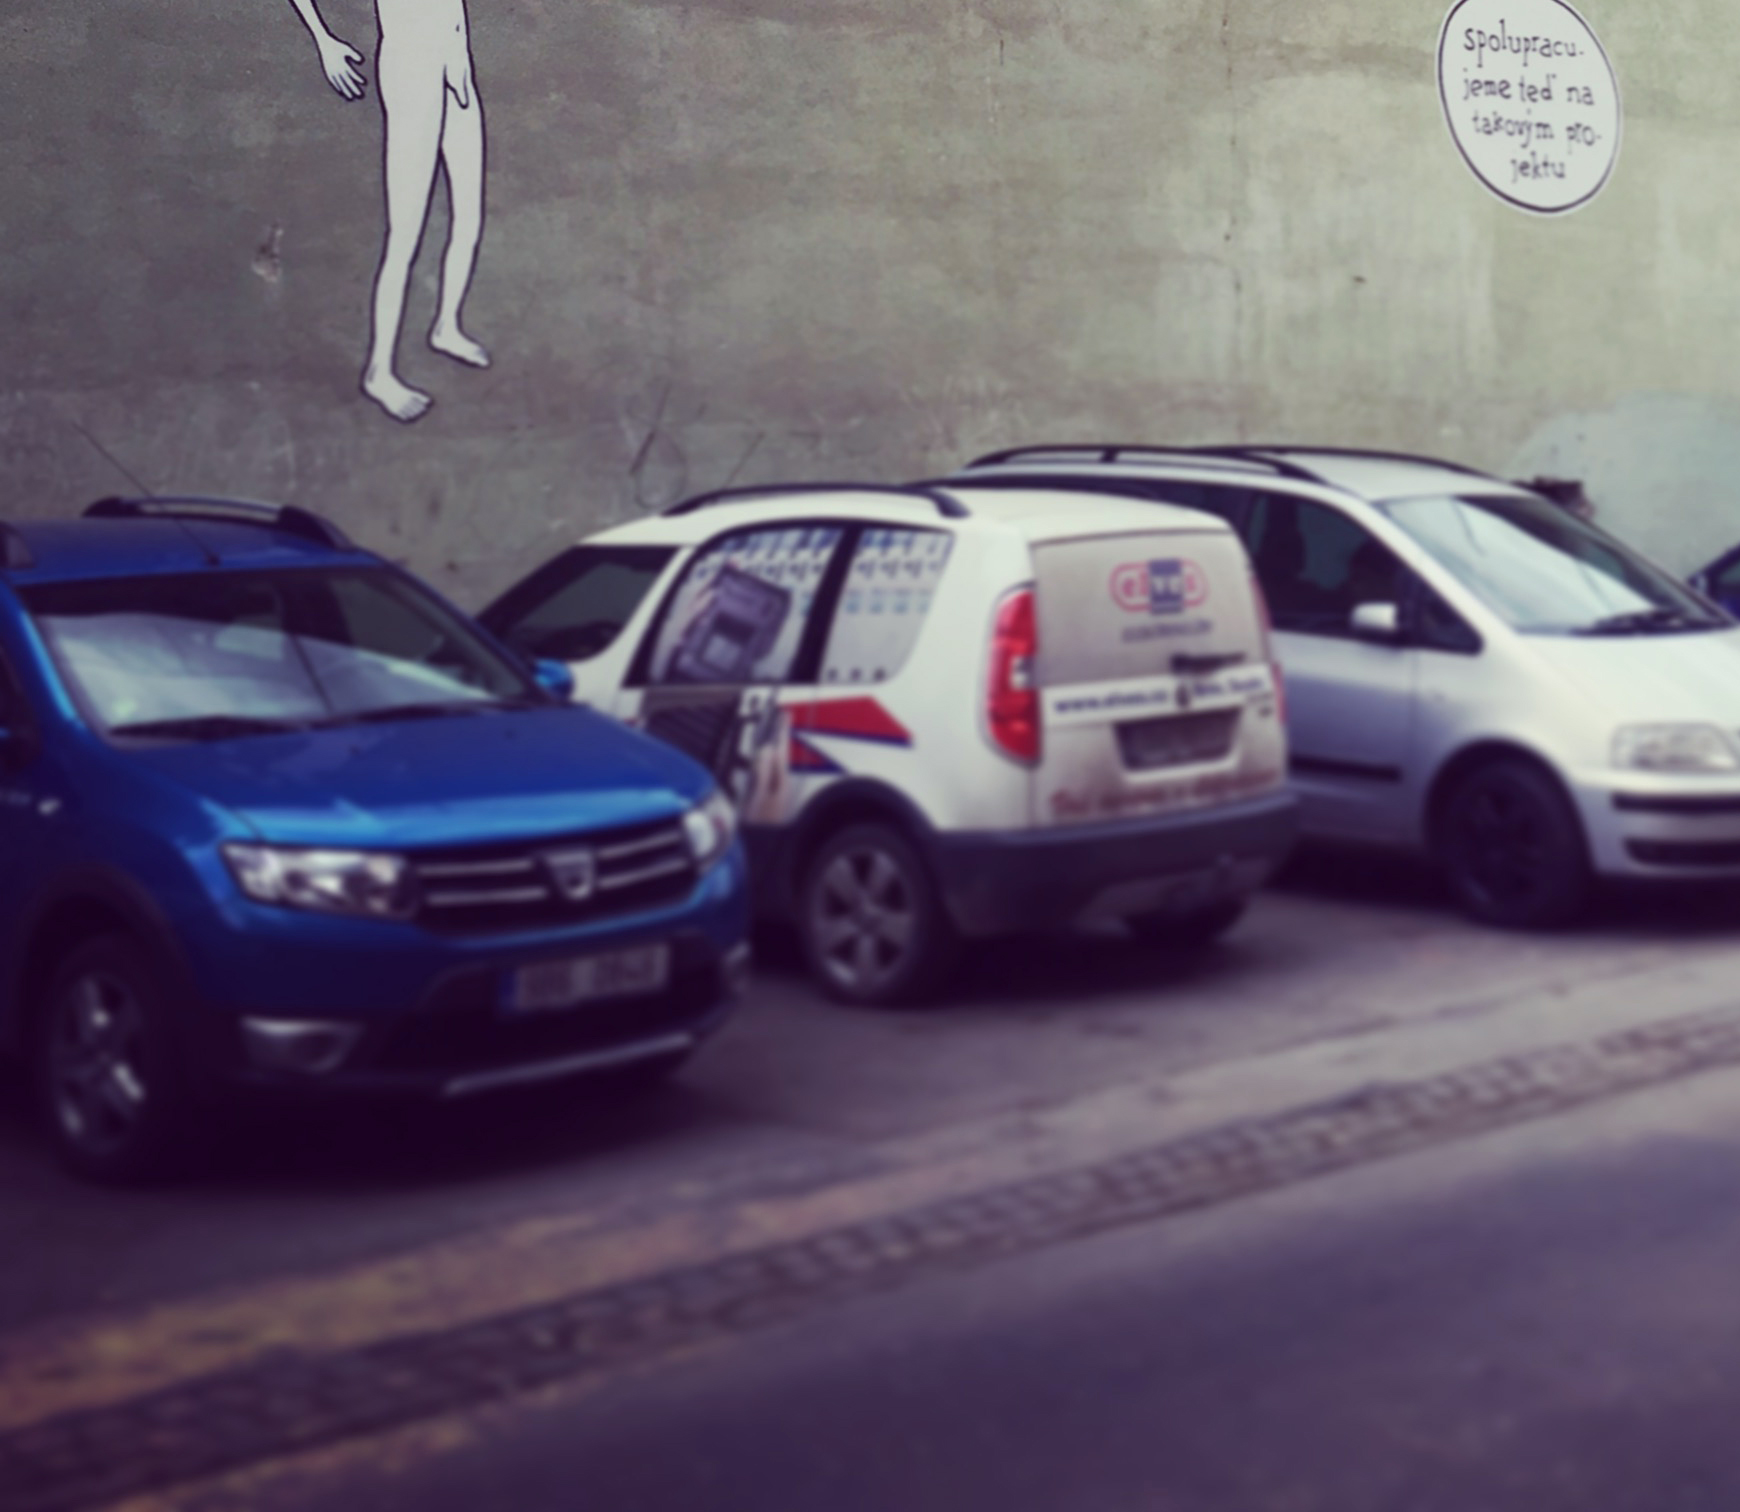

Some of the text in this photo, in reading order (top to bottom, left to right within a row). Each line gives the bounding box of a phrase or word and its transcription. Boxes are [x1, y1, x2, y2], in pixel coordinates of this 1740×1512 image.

[1463, 67, 1511, 100] jeme
[1566, 85, 1595, 106] na
[1472, 108, 1554, 149] takovým
[1511, 150, 1566, 183] jektu
